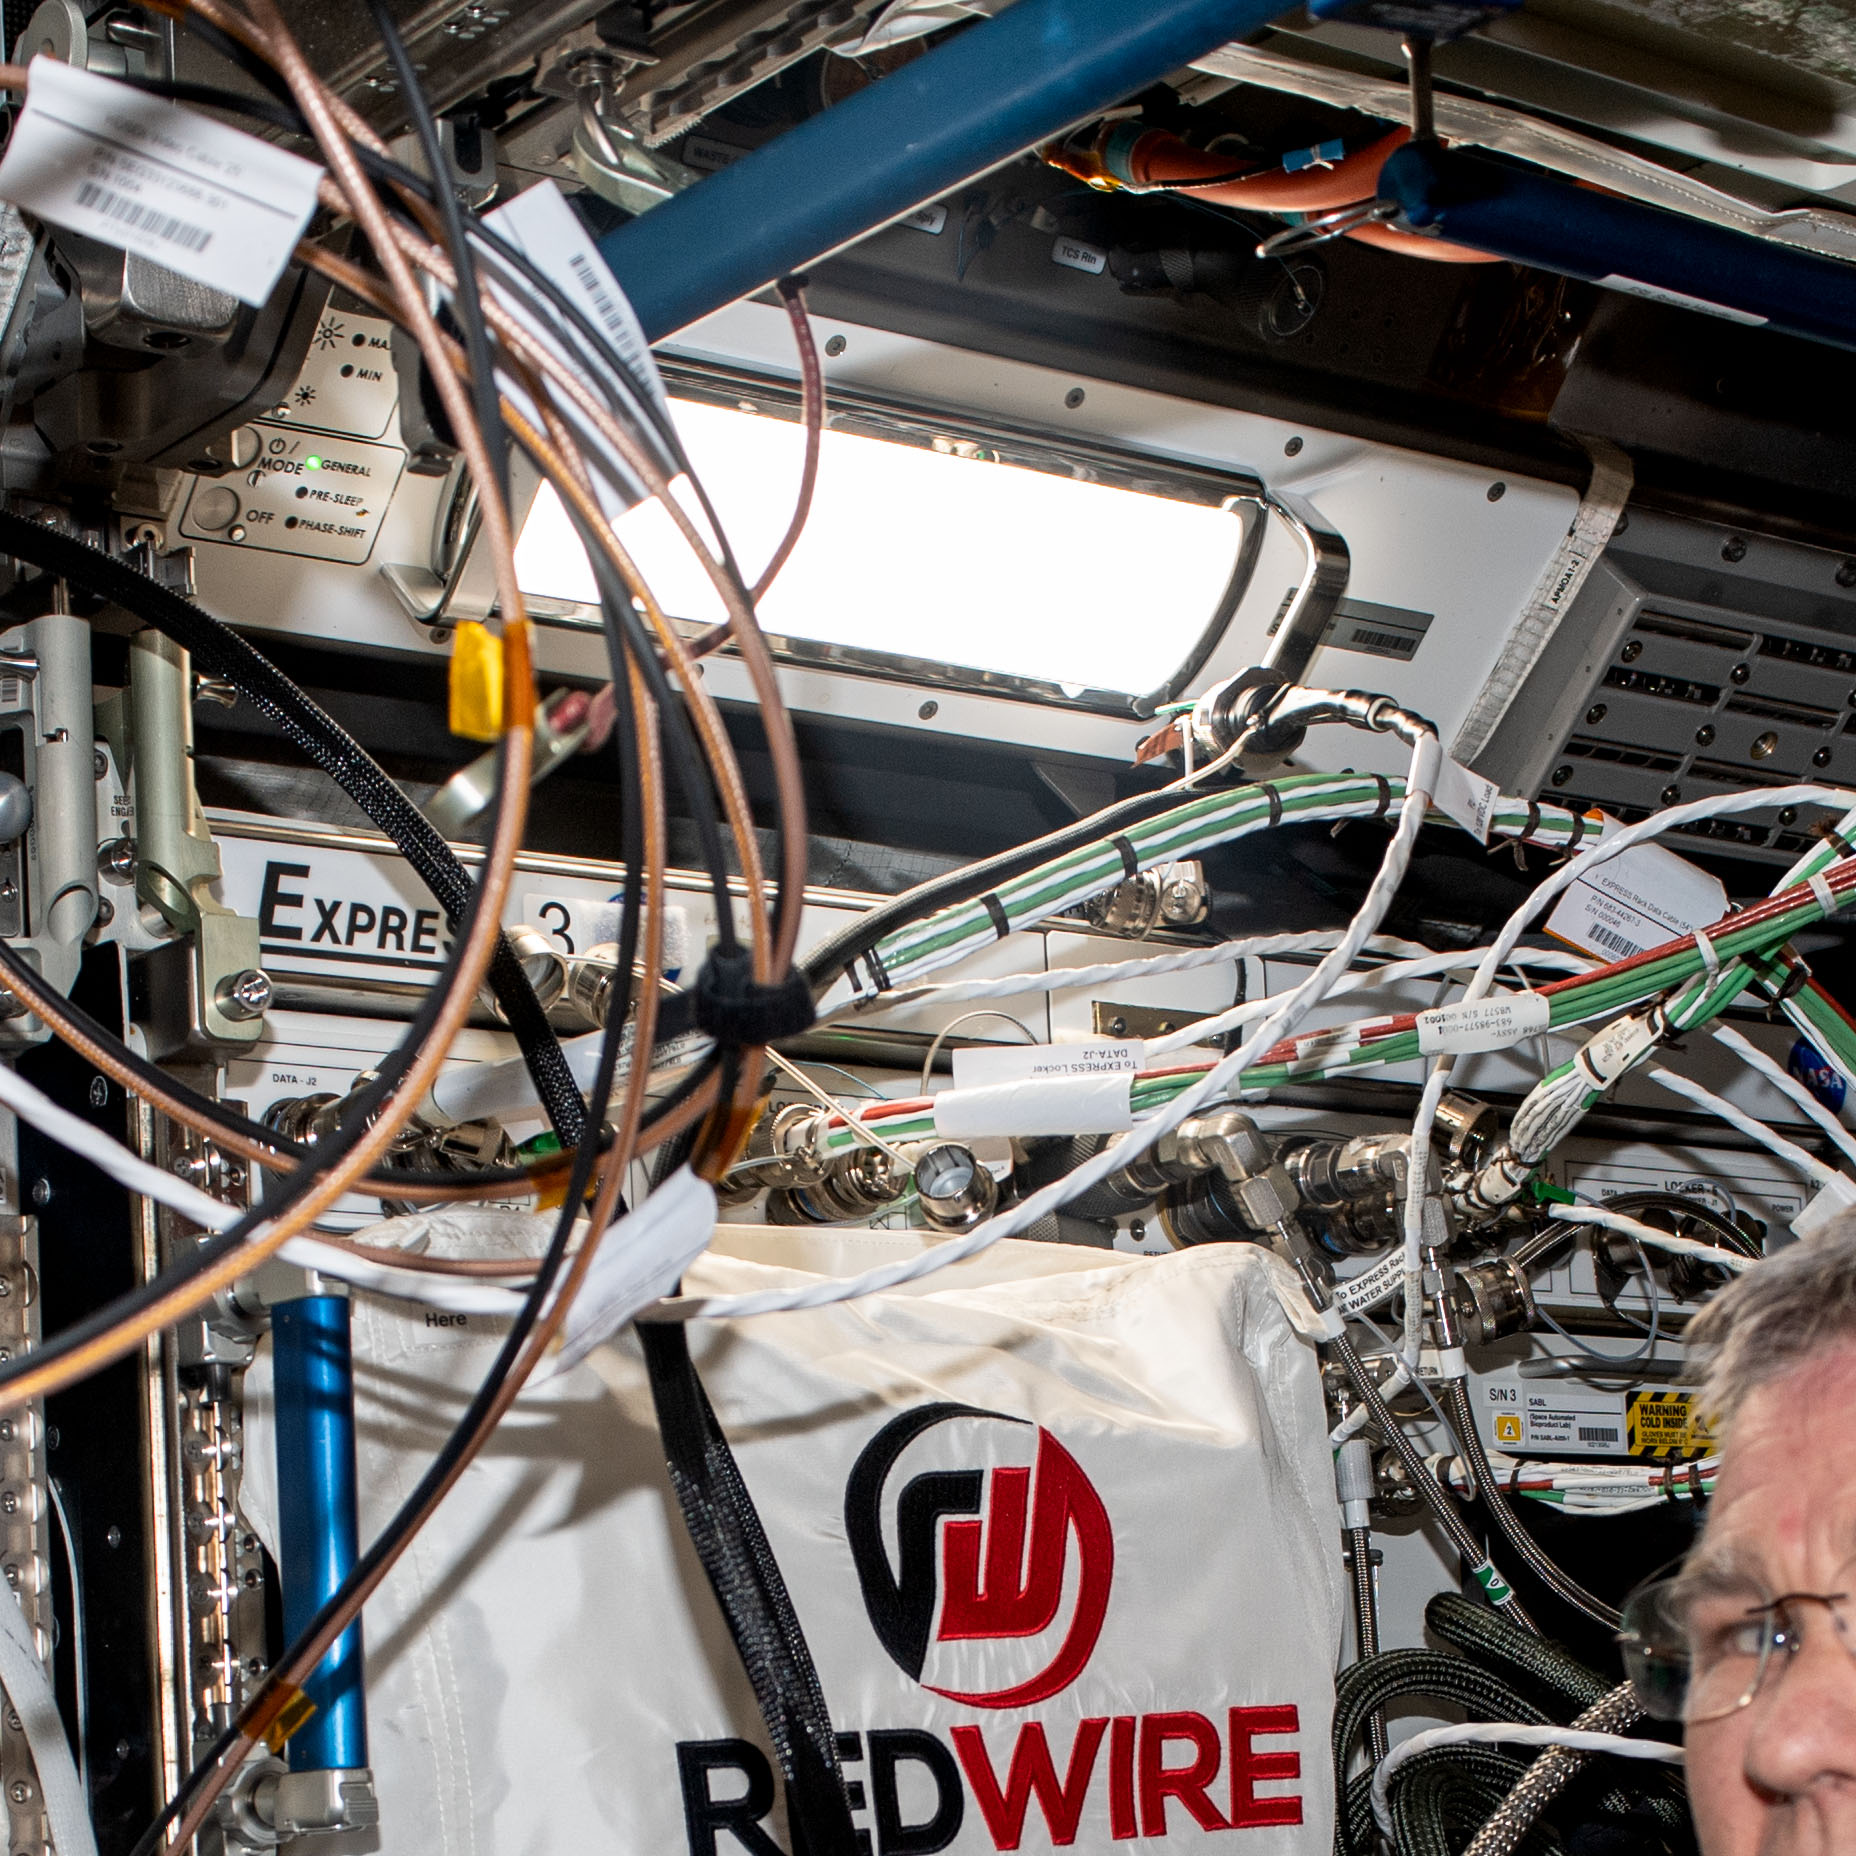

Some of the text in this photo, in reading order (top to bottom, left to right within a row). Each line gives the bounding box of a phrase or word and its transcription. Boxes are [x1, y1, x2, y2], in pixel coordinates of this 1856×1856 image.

[1062, 246, 1081, 259] TCS
[369, 338, 392, 350] MA
[356, 368, 383, 381] MIN
[259, 457, 304, 476] MODE
[322, 460, 372, 478] GENERAL
[310, 489, 364, 508] PRE-SLEEP
[246, 510, 274, 525] OFF
[300, 519, 367, 539] PHASE-SHIFT
[1600, 877, 1632, 904] EXPRESS
[1647, 903, 1663, 917] Data
[539, 902, 575, 956] 3
[1032, 1063, 1076, 1074] Locker
[1078, 1061, 1123, 1072] EXPRESS
[272, 1073, 317, 1086] DATA J2
[1795, 1066, 1845, 1090] NASA
[1772, 1204, 1794, 1213] POWER
[1348, 1267, 1390, 1298] EXPRESS
[1348, 1285, 1382, 1313] WATER
[425, 1312, 468, 1328] Here
[1489, 1389, 1517, 1402] S/N 3
[1529, 1398, 1546, 1407] SABL
[1639, 1403, 1687, 1418] WARNING
[1640, 1416, 1688, 1430] COLD INSIDE
